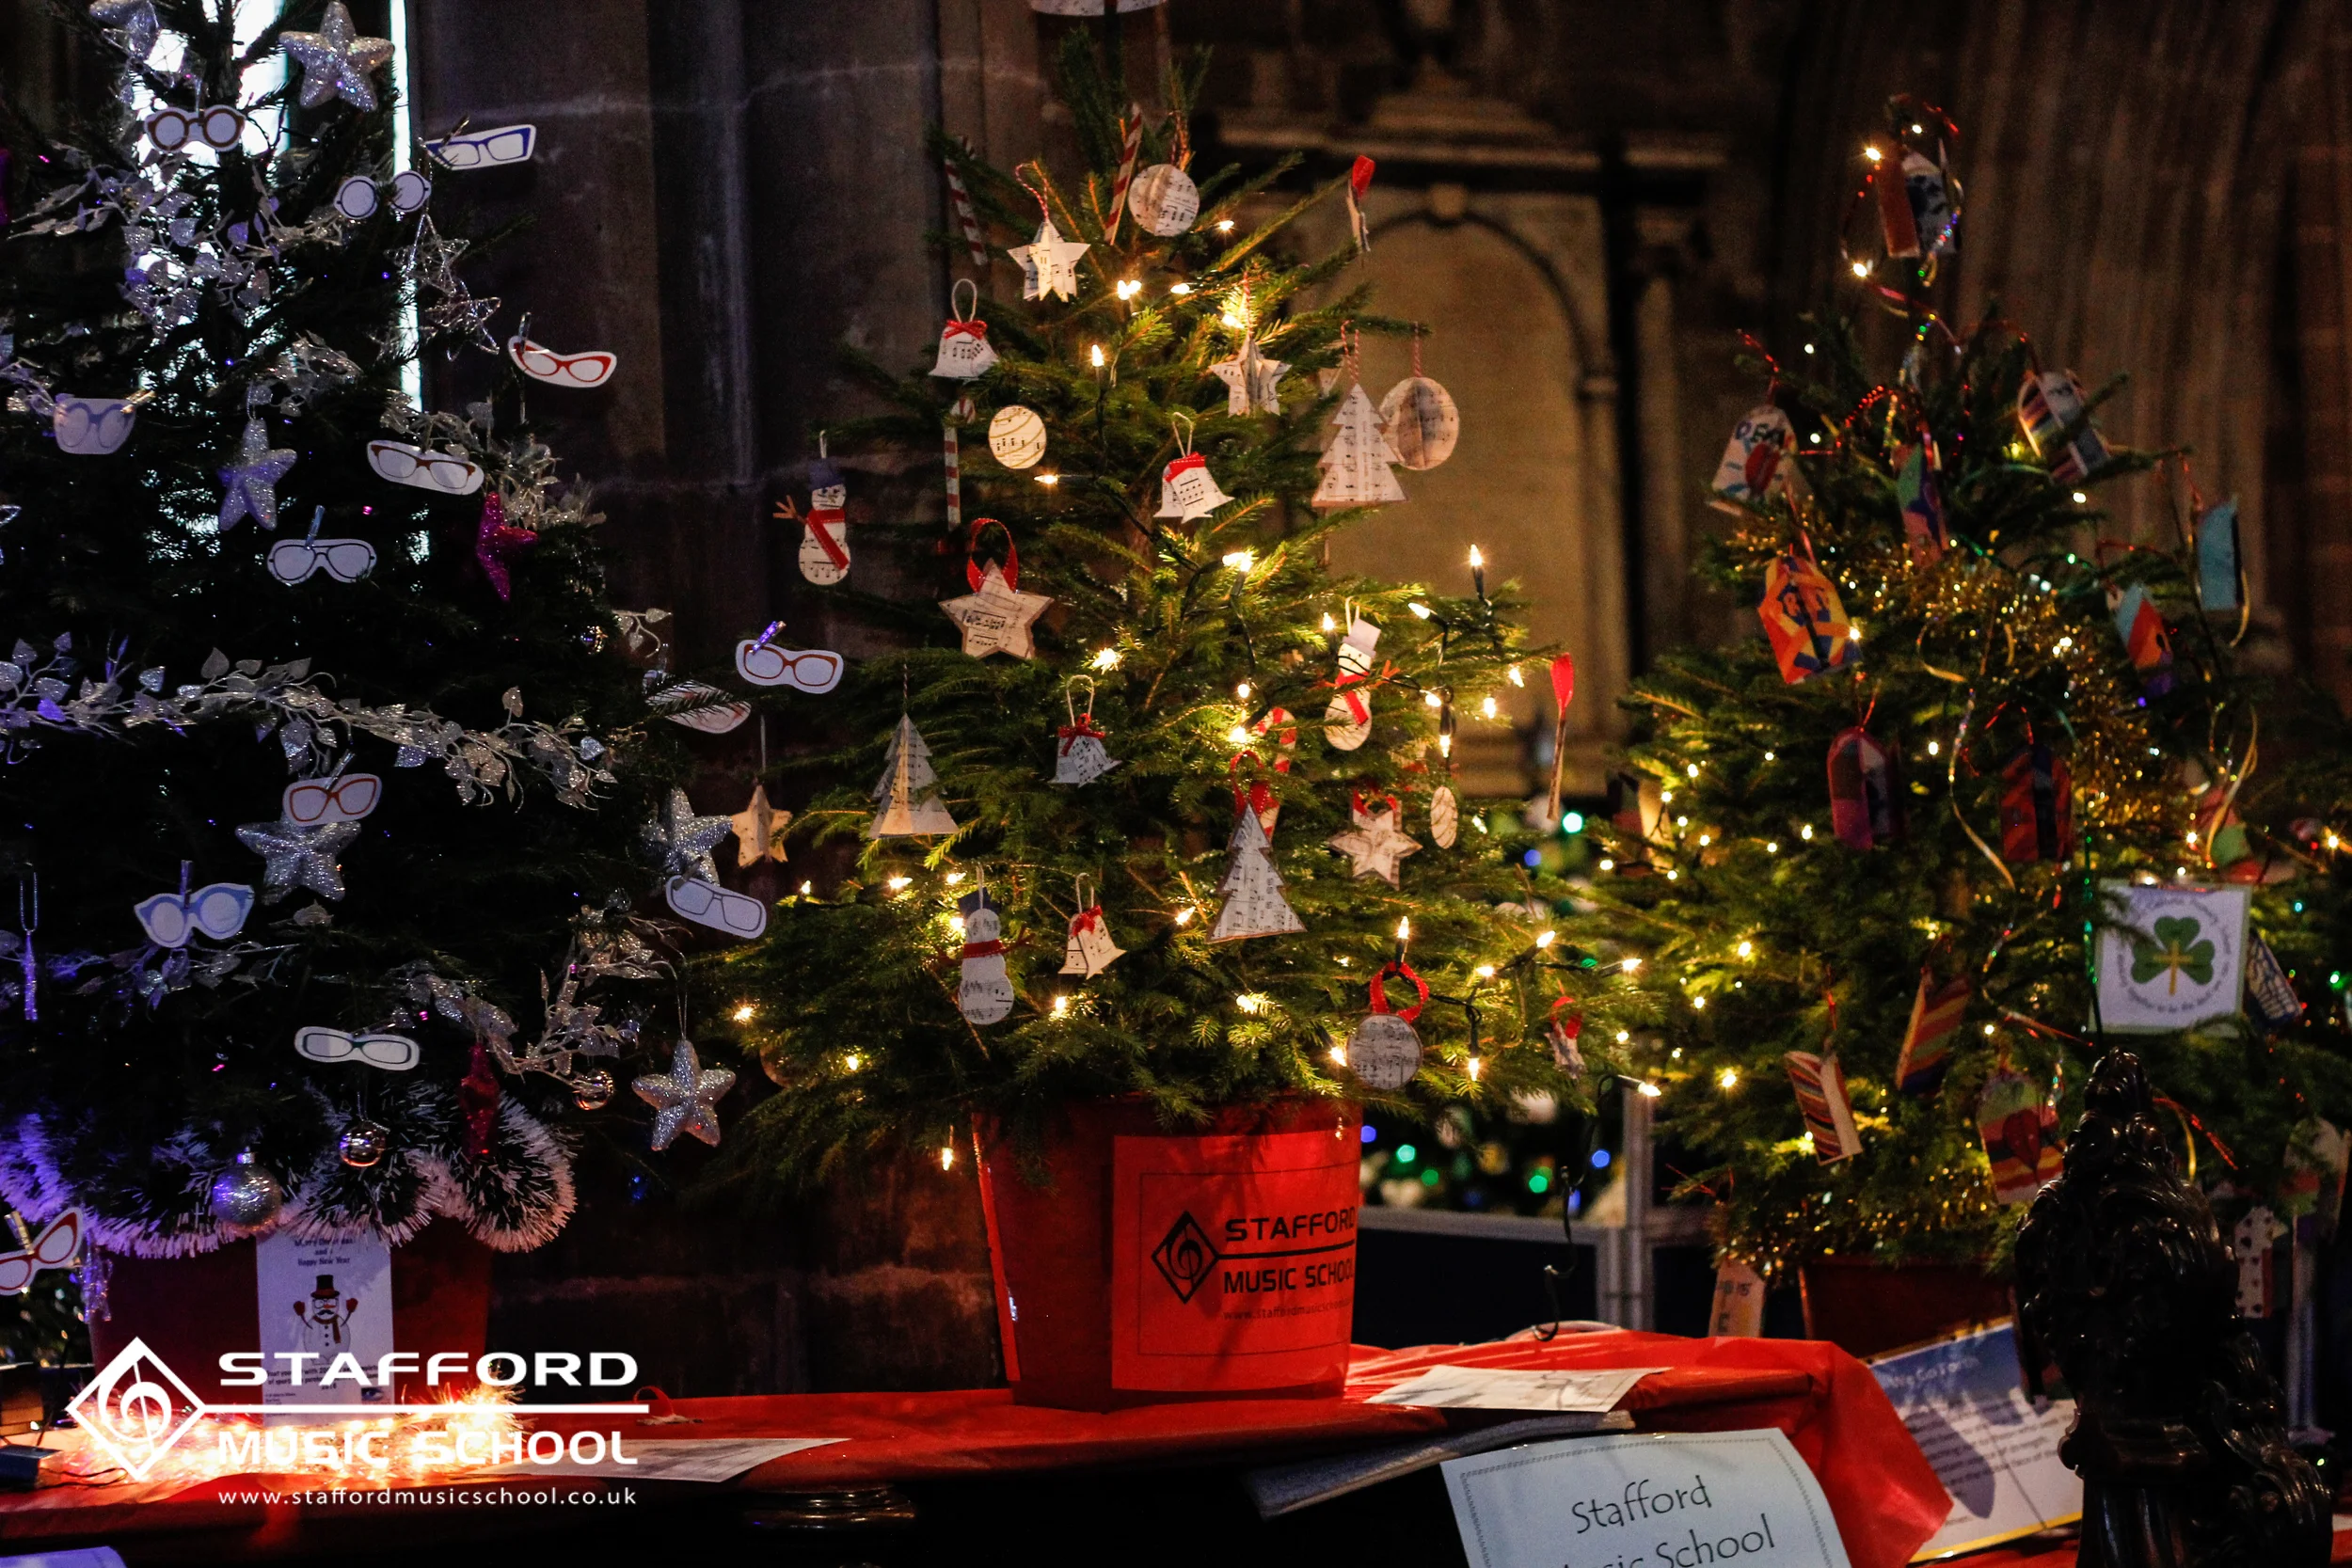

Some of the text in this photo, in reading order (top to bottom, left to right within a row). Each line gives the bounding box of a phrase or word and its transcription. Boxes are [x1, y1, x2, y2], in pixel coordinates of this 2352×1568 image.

[1225, 1206, 1356, 1243] STAFFORD
[297, 1256, 351, 1267] Happy New Year
[1223, 1259, 1355, 1294] MUSIC SCHOOL
[1571, 1473, 1713, 1534] Stafford
[1656, 1513, 1776, 1568] School
